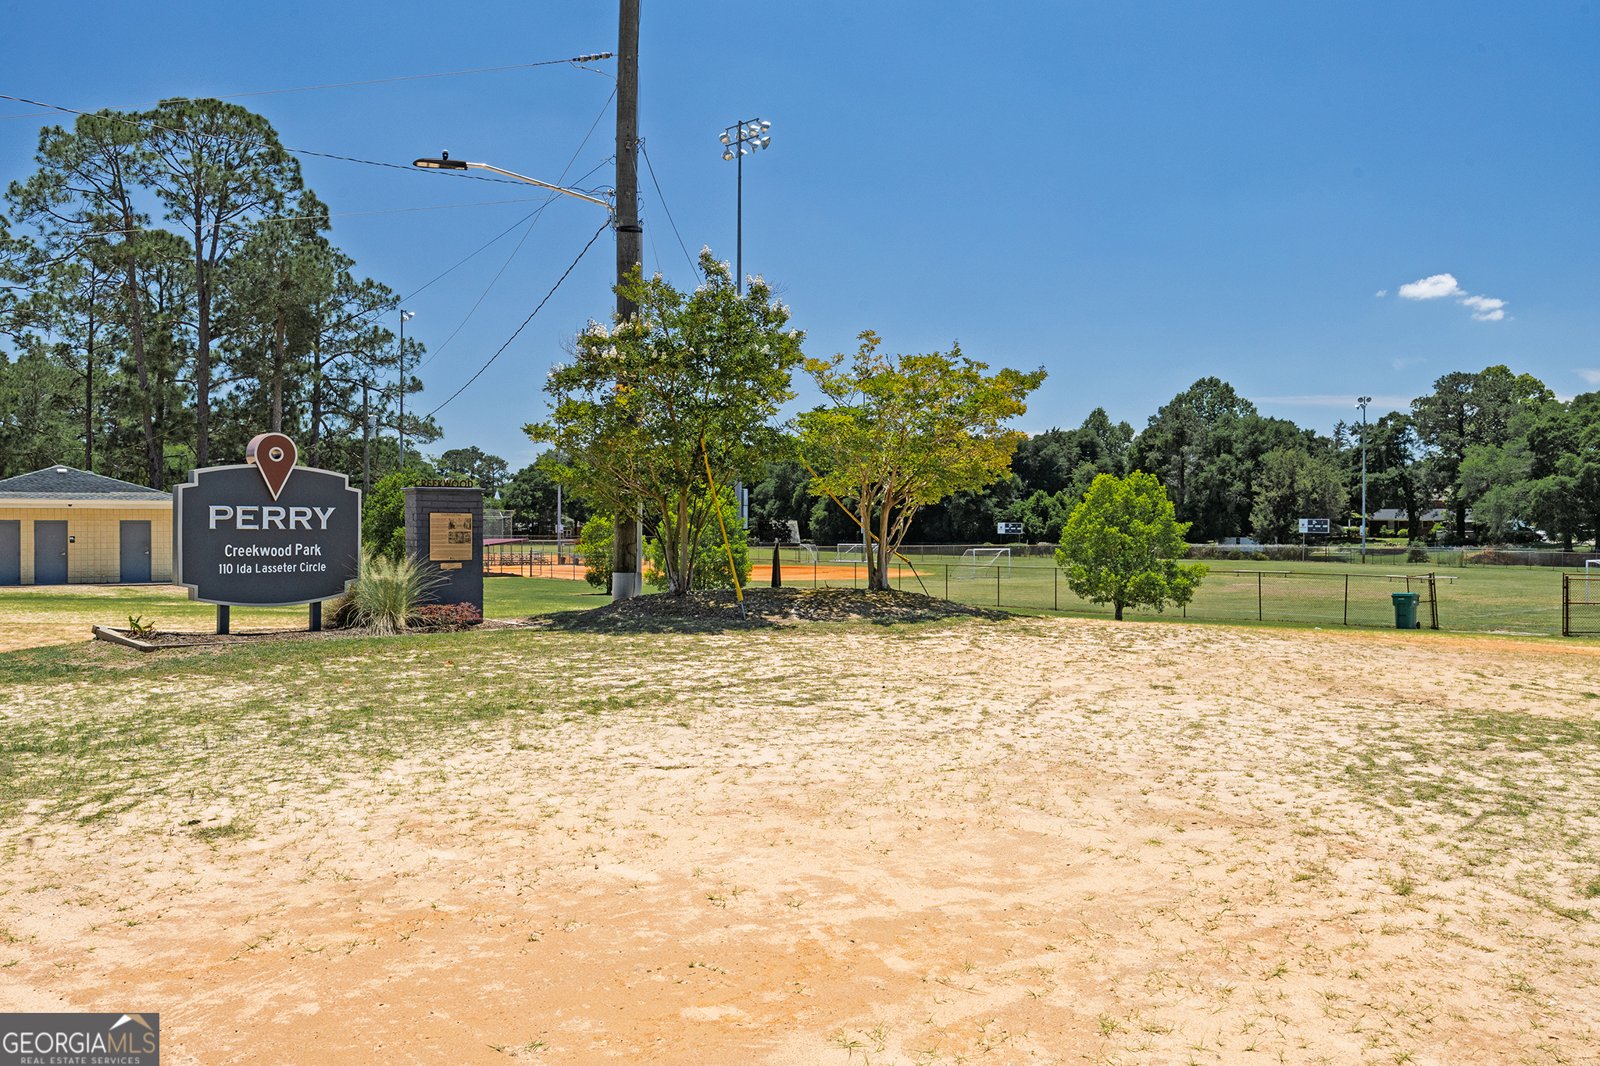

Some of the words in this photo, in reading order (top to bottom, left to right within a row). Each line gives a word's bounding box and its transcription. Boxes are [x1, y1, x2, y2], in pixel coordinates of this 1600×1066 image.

[209, 505, 336, 530] PERRY
[224, 544, 292, 557] Creekwood
[295, 543, 321, 556] Park
[218, 563, 233, 574] 110
[236, 563, 252, 574] Ida
[255, 562, 297, 574] Lasseter
[299, 562, 326, 572] Circle
